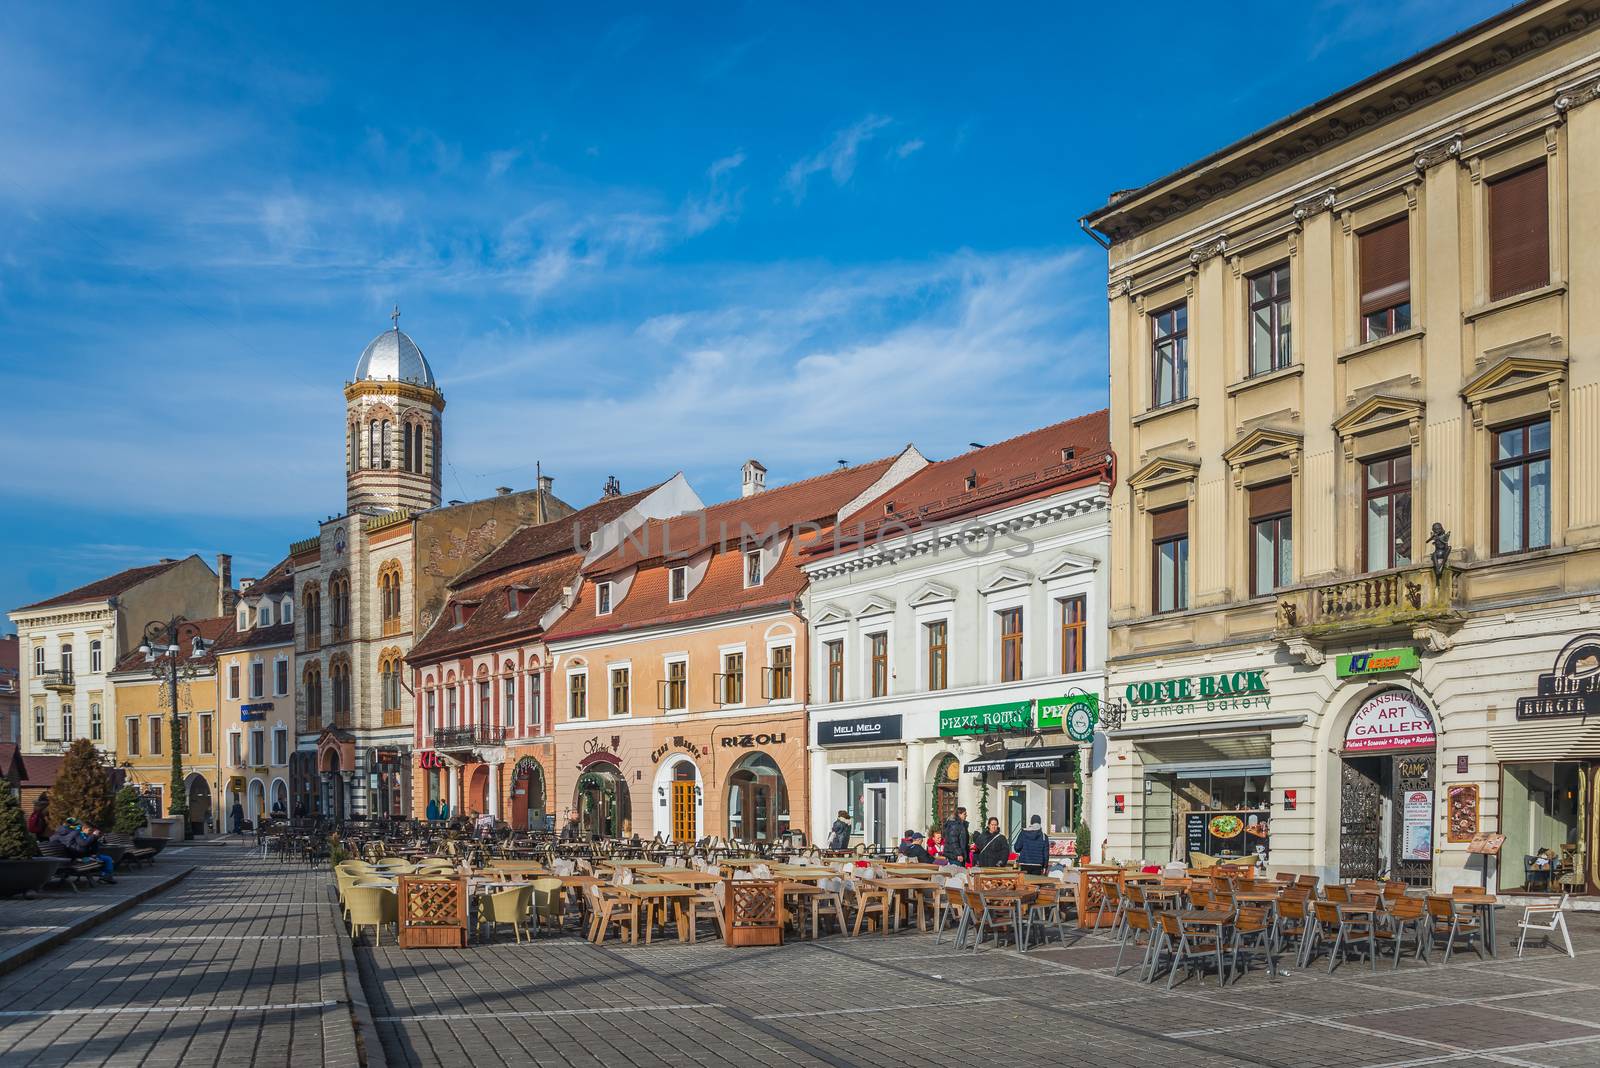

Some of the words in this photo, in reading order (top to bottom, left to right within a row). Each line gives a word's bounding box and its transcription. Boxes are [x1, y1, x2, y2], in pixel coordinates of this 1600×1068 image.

[1126, 678, 1195, 704] COME
[1199, 669, 1269, 696] BACK
[1131, 704, 1195, 721] german
[1207, 696, 1271, 712] bakery
[1357, 692, 1430, 721] TRANSILVANIA
[1378, 707, 1407, 719] ART
[1524, 698, 1585, 714] BURGER
[941, 714, 978, 729] PIZZA
[1355, 720, 1434, 735] GALLERY
